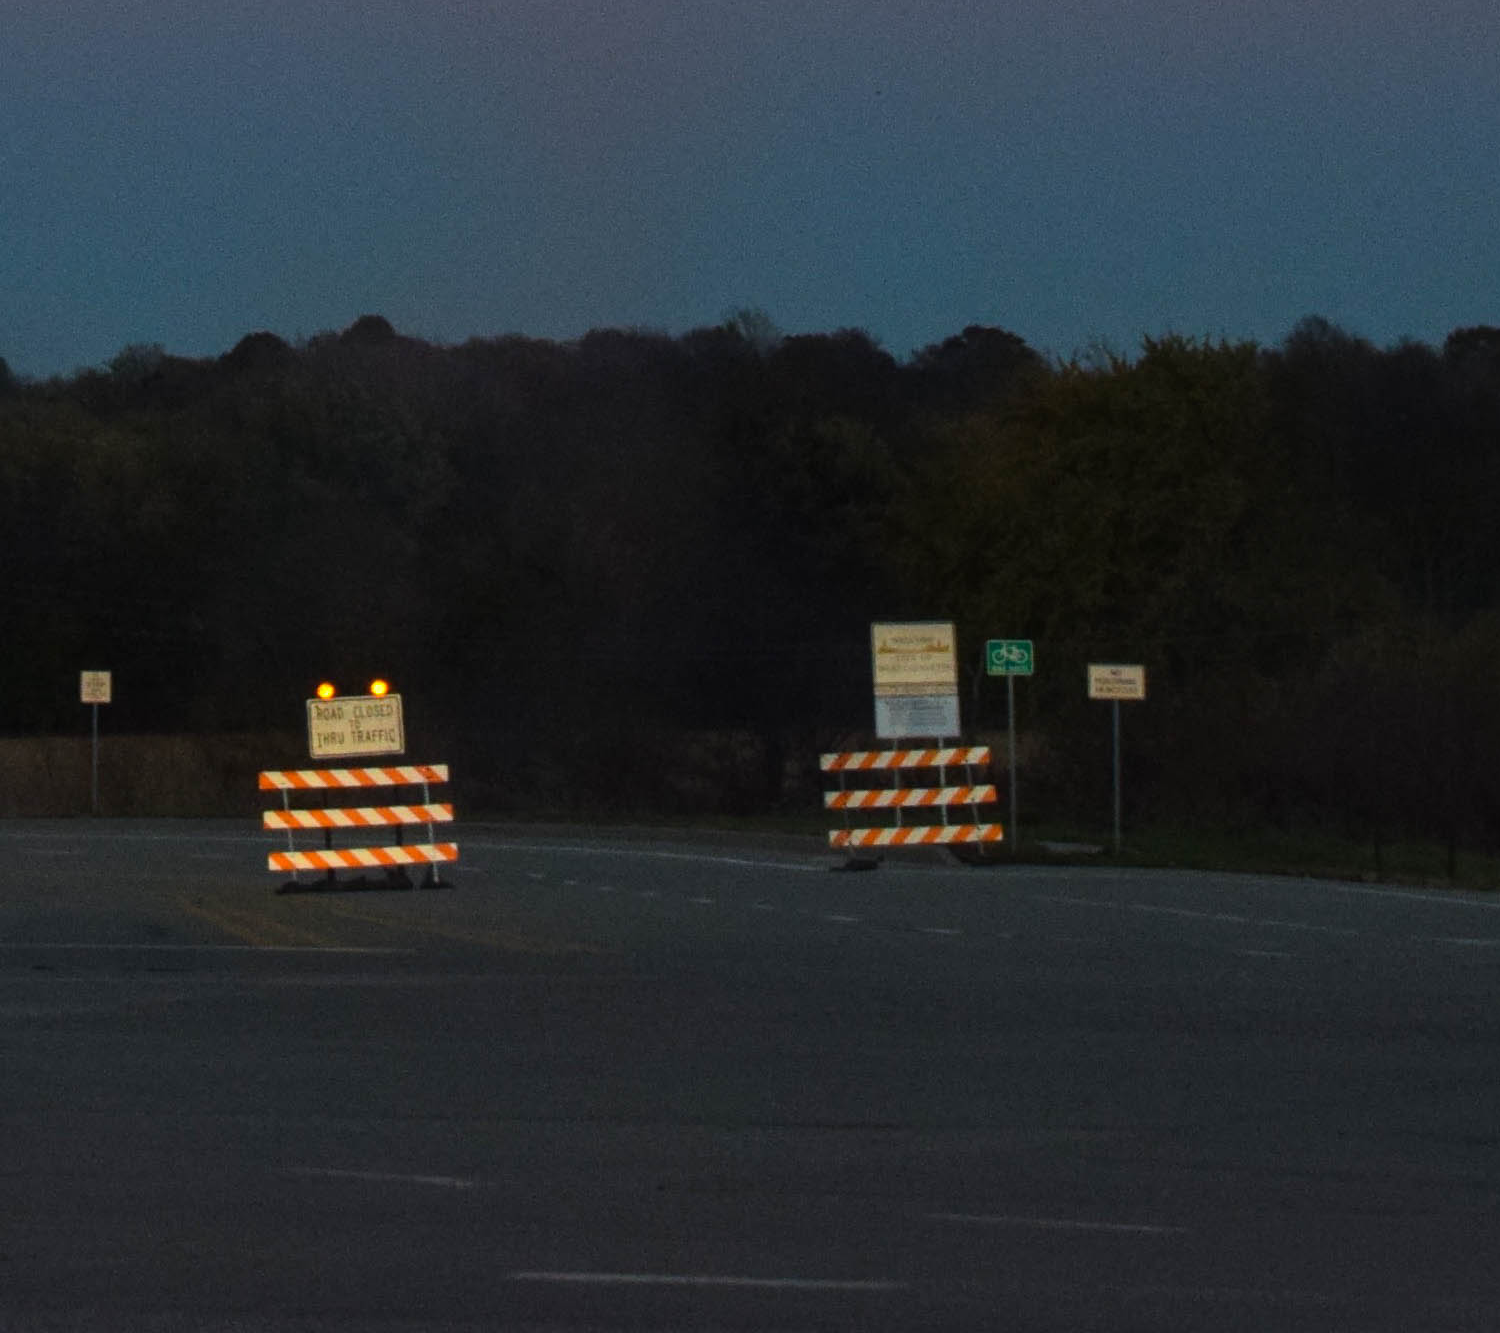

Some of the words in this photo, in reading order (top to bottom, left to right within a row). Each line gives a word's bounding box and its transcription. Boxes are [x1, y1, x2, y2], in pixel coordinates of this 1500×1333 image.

[315, 705, 344, 720] ROAD
[352, 704, 393, 718] CLOSED
[316, 732, 344, 747] THRU
[351, 728, 395, 743] TRAFFIC
